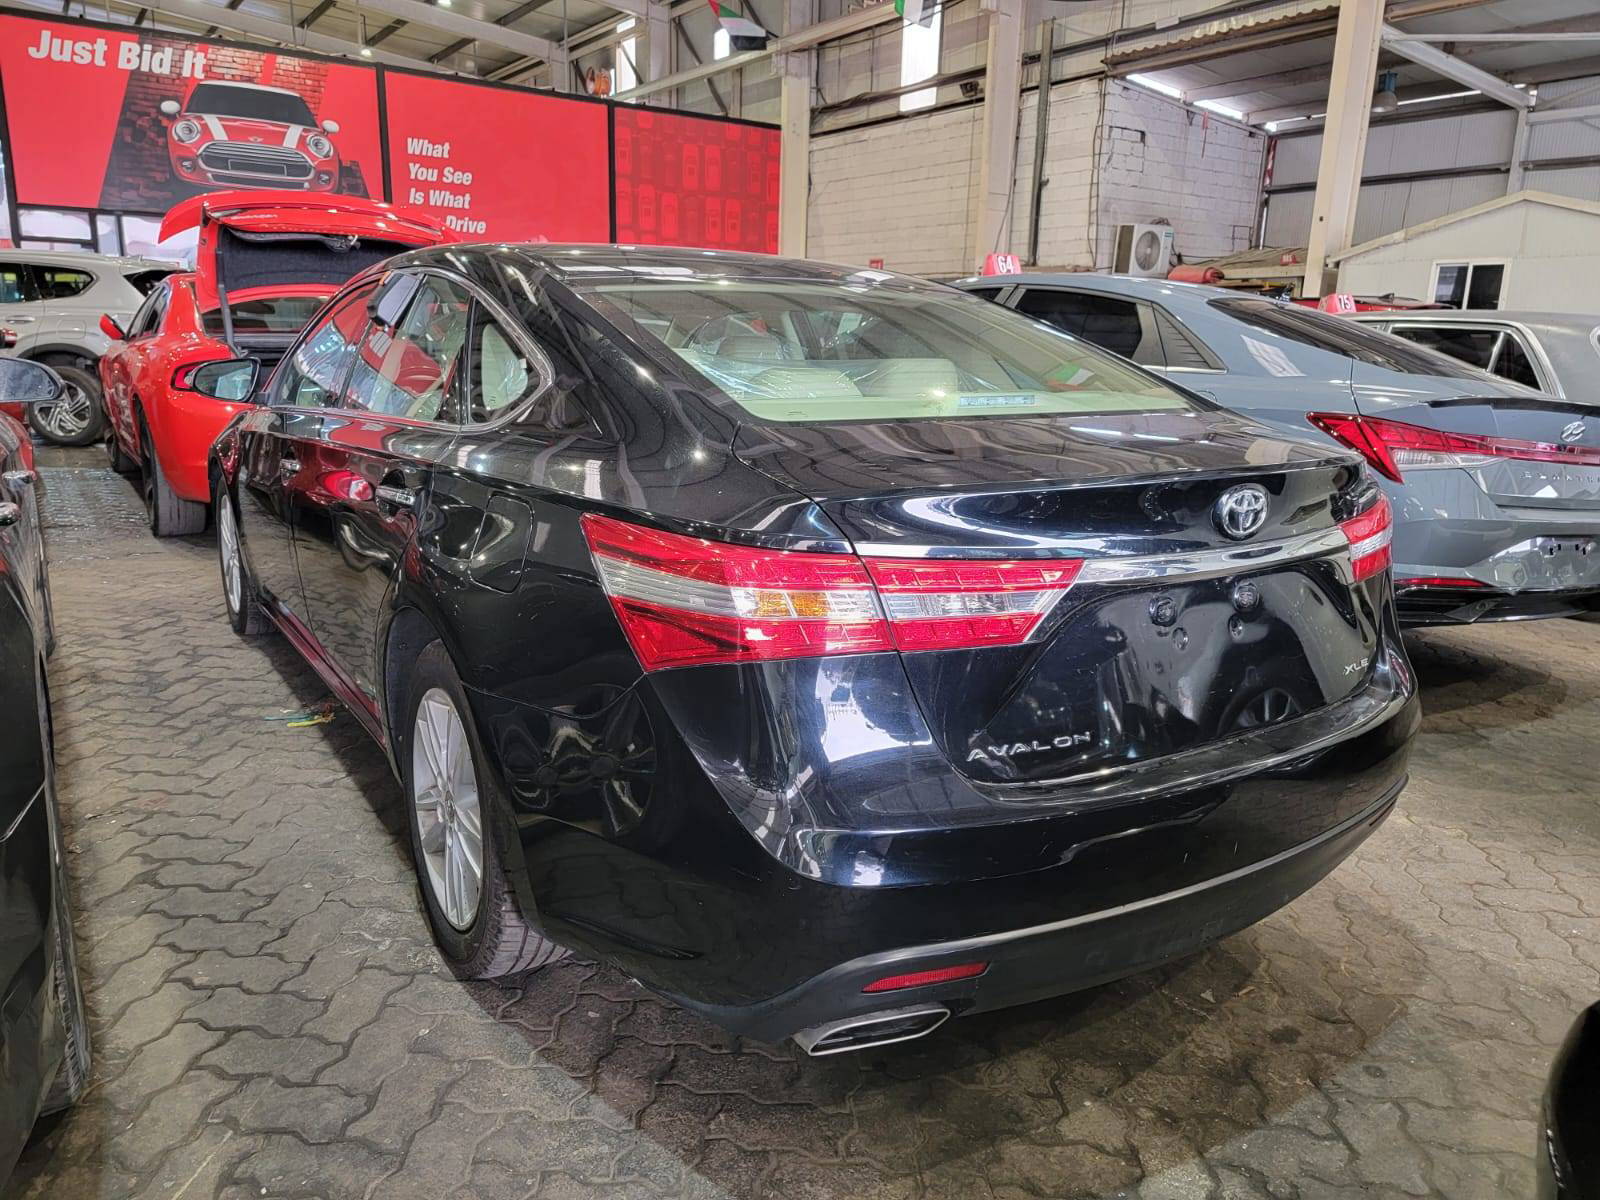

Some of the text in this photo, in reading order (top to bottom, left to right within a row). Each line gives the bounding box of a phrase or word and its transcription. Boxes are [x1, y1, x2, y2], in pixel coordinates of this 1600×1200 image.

[28, 29, 207, 79] Just Bid It
[407, 137, 450, 158] What
[408, 162, 473, 185] You See
[408, 187, 471, 209] Is What
[445, 214, 487, 234] Drive
[997, 255, 1015, 273] 64
[1343, 657, 1369, 676] XLE
[966, 731, 1092, 762] AVALON
